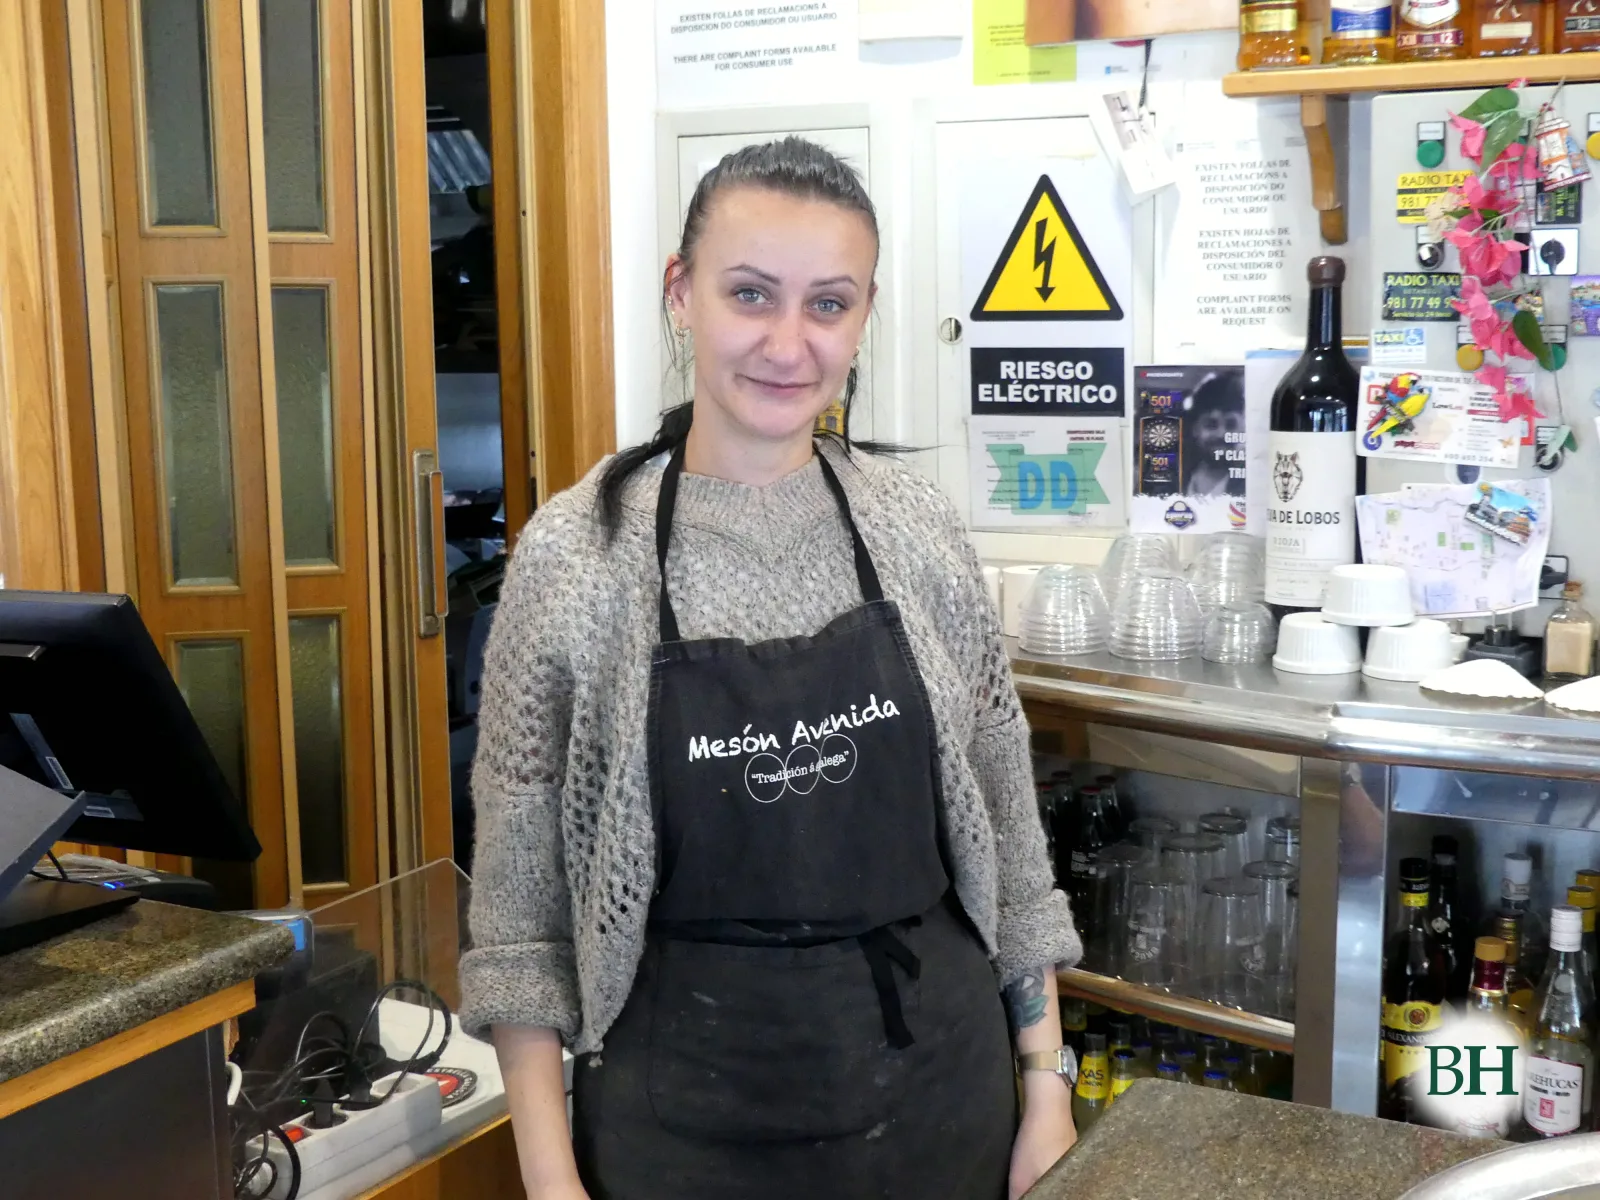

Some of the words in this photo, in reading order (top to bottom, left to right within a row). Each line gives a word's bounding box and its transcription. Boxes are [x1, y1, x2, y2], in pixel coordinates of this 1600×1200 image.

[680, 13, 711, 22] EXISTEN
[713, 10, 742, 20] FOLLAS
[744, 8, 755, 17] DE
[757, 3, 819, 16] RECLAMACIONS
[720, 21, 732, 30] DO
[734, 16, 786, 28] CONSUMIDOR
[788, 16, 799, 24] OU
[801, 12, 837, 22] USUARIO
[1578, 18, 1590, 30] 12
[1440, 32, 1454, 44] 12
[674, 55, 698, 64] THERE
[700, 53, 715, 61] ARE
[718, 50, 761, 60] COMPLAINT
[764, 47, 790, 56] FORMS
[792, 44, 836, 54] AVAILABLE
[715, 62, 730, 71] FOR
[732, 60, 776, 70] CONSUMER
[778, 58, 793, 66] USE
[1195, 162, 1237, 172] EXISTEN
[1240, 160, 1277, 170] FOLLAS
[1279, 159, 1291, 168] DE
[1200, 172, 1280, 182] RECLAMACIONS
[1281, 171, 1288, 179] A
[1401, 174, 1440, 186] RADIO
[1205, 182, 1268, 194] DISPOSICIÓN
[1270, 182, 1284, 191] DO
[1202, 194, 1270, 205] CONSUMIDOR
[1272, 194, 1286, 202] OU
[1401, 197, 1420, 208] 981
[1223, 206, 1267, 215] USUARIO
[1199, 228, 1240, 238] EXISTEN
[1243, 228, 1275, 237] HOJAS
[1278, 227, 1290, 236] DE
[1198, 239, 1283, 249] RECLAMACIONES
[1202, 249, 1265, 259] DISPOSICIÓN
[1268, 250, 1287, 258] DEL
[1206, 261, 1273, 270] CONSUMIDOR
[1276, 261, 1283, 269] O
[1223, 273, 1267, 281] USUARIO
[1386, 274, 1428, 286] RADIO
[1430, 274, 1460, 286] TAXI
[1197, 295, 1256, 304] COMPLAINT
[1258, 294, 1292, 303] FORMS
[1387, 296, 1406, 308] 981
[1410, 296, 1424, 308] 77
[1426, 297, 1441, 308] 49
[1197, 307, 1217, 315] ARE
[1219, 306, 1274, 315] AVAILABLE
[1276, 306, 1292, 314] ON
[1222, 317, 1266, 327] REQUEST
[1000, 361, 1093, 381] RIESGO
[978, 380, 1118, 404] ELÉCTRICO
[1151, 395, 1172, 407] 501
[1152, 457, 1168, 466] 501
[1279, 510, 1292, 524] DE
[1296, 510, 1340, 525] LOBOS
[1273, 537, 1300, 547] RIOJA
[689, 724, 781, 762] Mesón
[791, 694, 900, 745] Avenida
[1082, 1069, 1104, 1080] KAS
